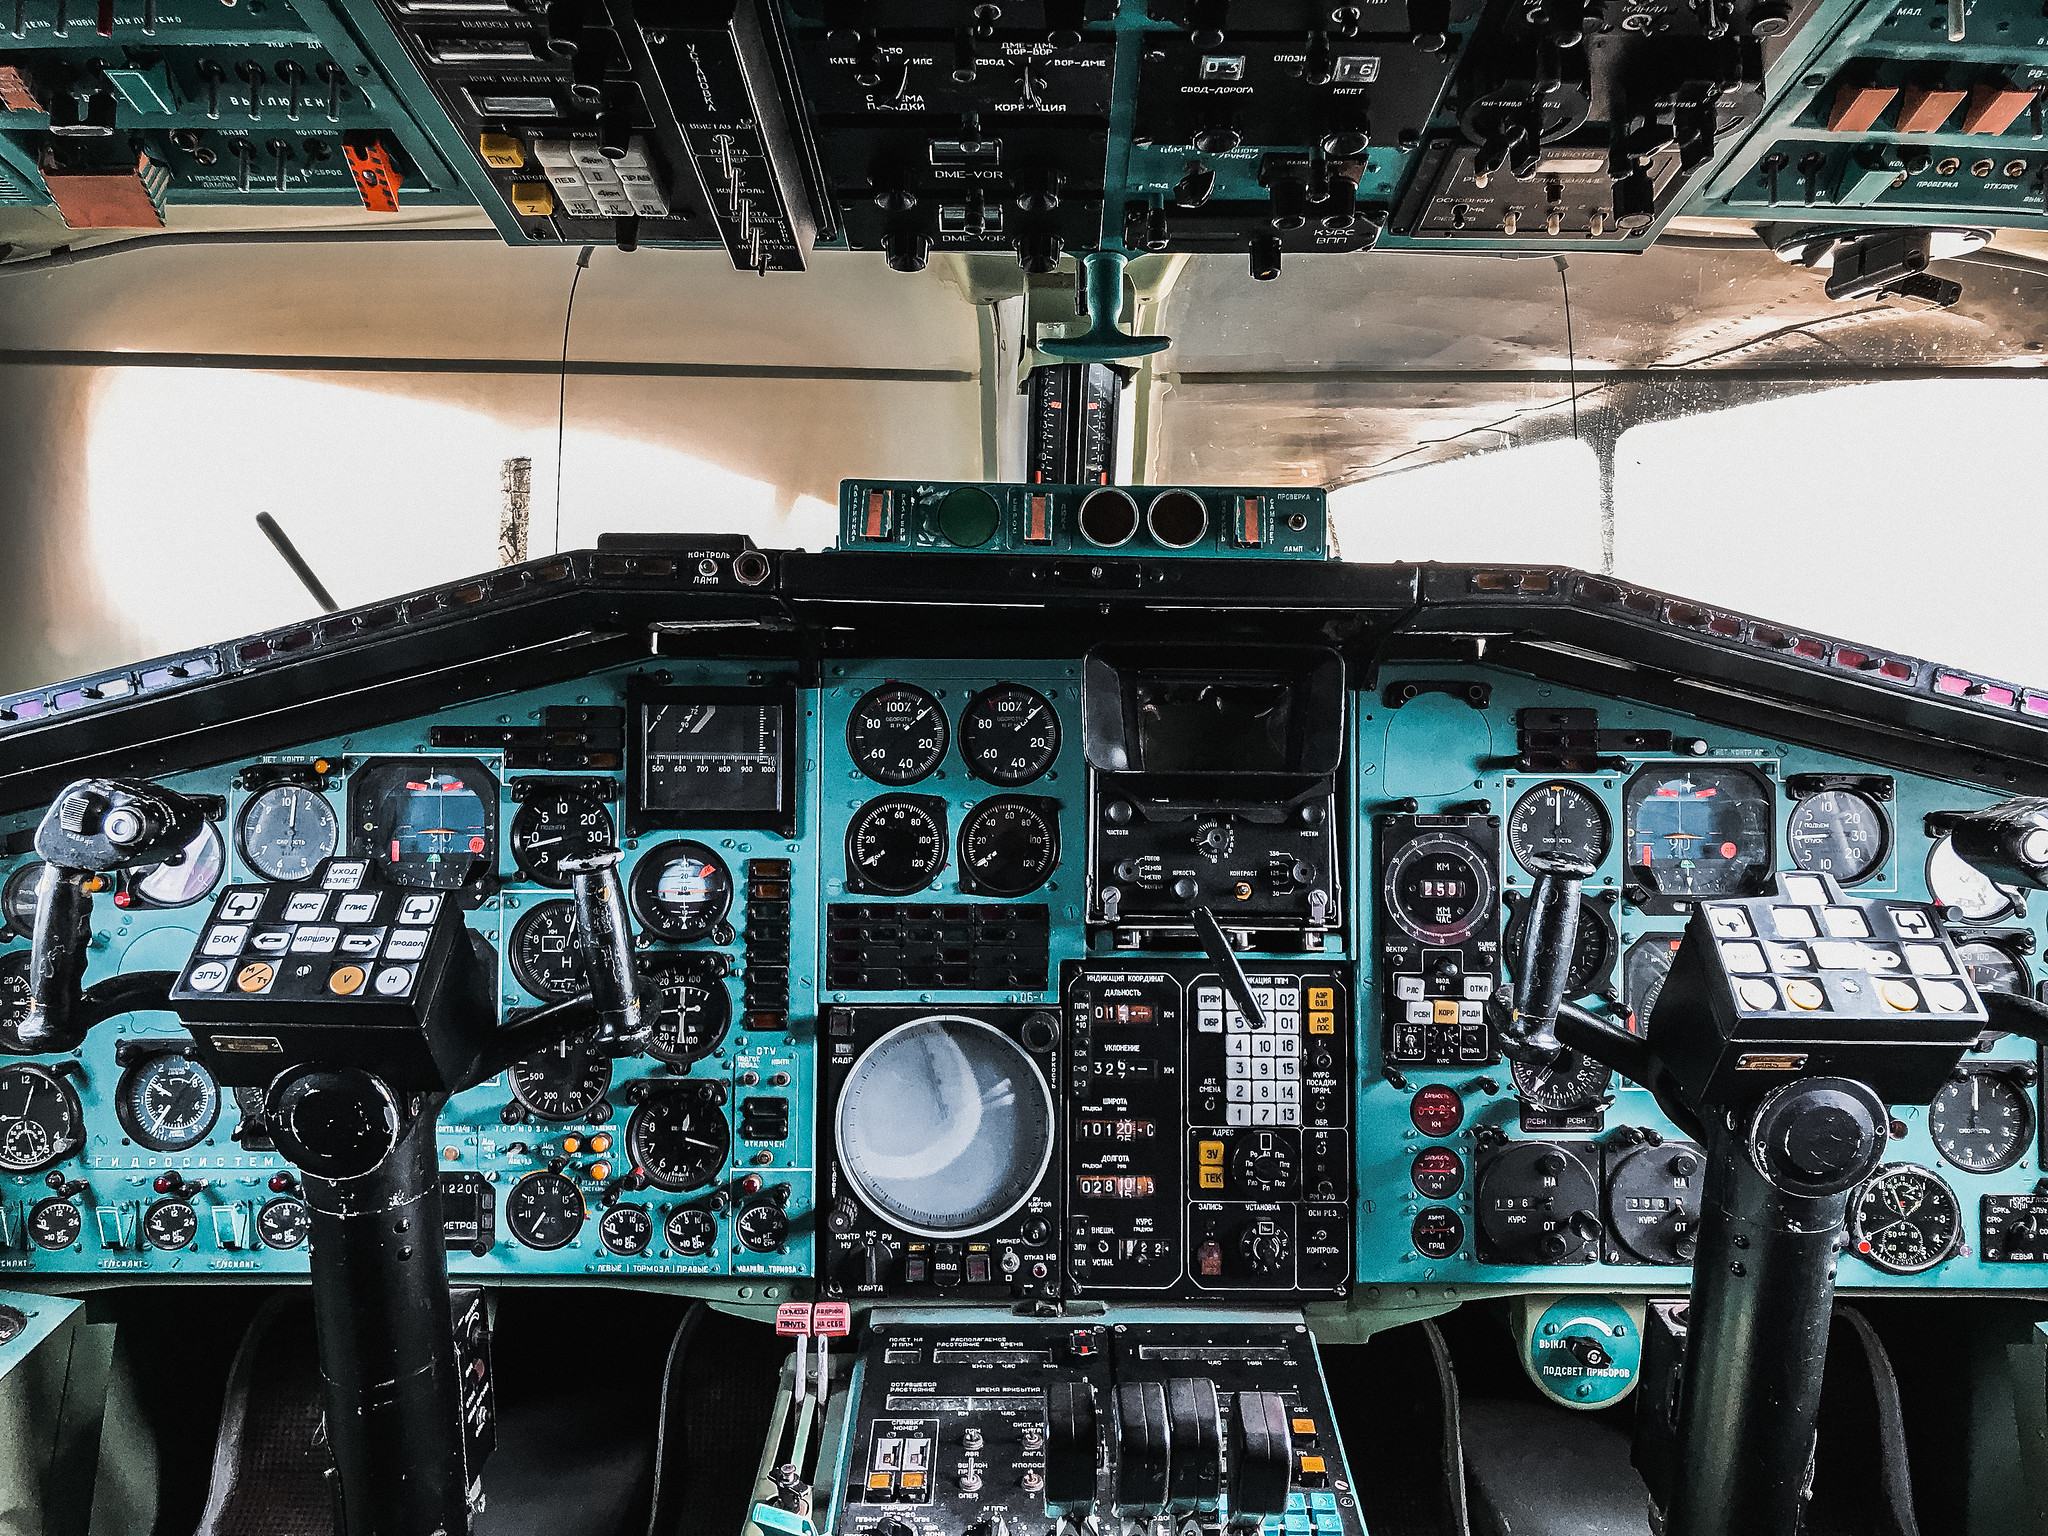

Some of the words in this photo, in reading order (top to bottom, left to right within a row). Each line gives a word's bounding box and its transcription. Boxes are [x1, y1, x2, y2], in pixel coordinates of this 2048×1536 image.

[1181, 86, 1254, 94] СВОД-ДОРОГА
[935, 170, 1003, 179] DME-VOR
[688, 551, 730, 559] КОНТРОЛЬ
[693, 576, 719, 584] ЛАМП
[886, 702, 912, 713] 100%
[997, 702, 1022, 712] 100%
[866, 719, 881, 729] 80
[978, 719, 992, 729] 80
[918, 739, 933, 748] 20
[1030, 738, 1044, 747] 20
[871, 749, 885, 759] 60
[983, 749, 997, 759] 60
[898, 758, 913, 768] 40
[1011, 758, 1025, 768] 40
[556, 802, 568, 814] 10
[580, 814, 596, 825] 20
[587, 831, 603, 842] 30
[1851, 830, 1867, 842] 30
[1437, 862, 1450, 871] КМ
[291, 902, 318, 911] КУРС
[1436, 906, 1451, 914] КМ
[1435, 915, 1452, 924] ЧАС
[212, 935, 238, 944] БОК
[296, 935, 335, 943] МАРШРУТ
[391, 940, 424, 948] ПРОДОЛ
[194, 971, 221, 980] ЗПУ
[1086, 975, 1125, 983] ИНДИКАЦИЯ
[1127, 975, 1164, 983] КООРДИНАТ
[1104, 989, 1142, 997] ДАЛЬНОСТЬ
[1406, 986, 1419, 994] РЛС
[1469, 985, 1489, 993] ОТКЛ
[1200, 994, 1221, 1003] ПРЯМ
[1279, 994, 1295, 1006] 02
[1074, 1002, 1089, 1010] ППМ
[1413, 1010, 1431, 1019] РСБН
[1438, 1008, 1454, 1017] КОРР
[1461, 1009, 1481, 1018] РСДН
[1204, 1018, 1219, 1027] ОБР
[1281, 1018, 1294, 1028] 01
[1316, 1024, 1330, 1032] ПОС
[1104, 1044, 1140, 1052] УКЛОНЕНИЕ
[1259, 1040, 1271, 1052] 10
[1281, 1040, 1294, 1051] 16
[832, 1056, 854, 1064] КАДР
[1282, 1063, 1294, 1075] 15
[529, 1072, 544, 1080] 500
[1306, 1079, 1337, 1087] ПОСАДКИ
[1199, 1085, 1221, 1093] СМЕНА
[1281, 1085, 1294, 1097] 14
[569, 1091, 581, 1099] 100
[1282, 1109, 1294, 1121] 13
[1212, 1128, 1234, 1137] АДРЕС
[1101, 1155, 1130, 1163] ДОЛГОТА
[1206, 1150, 1219, 1159] ЗУ
[1204, 1173, 1222, 1183] ТЕК
[1543, 1177, 1556, 1188] НА
[1673, 1177, 1686, 1188] НА
[538, 1187, 545, 1195] 13
[552, 1186, 559, 1195] 14
[527, 1196, 534, 1204] 12
[563, 1196, 569, 1204] 15
[1198, 1203, 1223, 1211] ЗАПИСЬ
[1245, 1203, 1281, 1212] УСТАНОВКА
[1135, 1217, 1153, 1225] КУРС
[1507, 1216, 1527, 1224] КУРС
[1638, 1216, 1658, 1225] КУРС
[1543, 1221, 1555, 1231] ОТ
[1674, 1222, 1686, 1232] ОТ
[841, 1241, 852, 1249] НУ
[1428, 1242, 1445, 1250] ГРАД
[1306, 1246, 1339, 1254] КОНТРОЛЬ
[677, 1265, 708, 1273] ПРАВЫЕ
[935, 1263, 958, 1271] ВВОД
[857, 1284, 883, 1292] КАРТА
[779, 1320, 806, 1328] ТЯНУТЬ
[1539, 1339, 1566, 1349] ВЫКЛ
[1543, 1366, 1583, 1376] ПОДСВЕТ
[1586, 1368, 1630, 1378] ПРИБОРОВ
